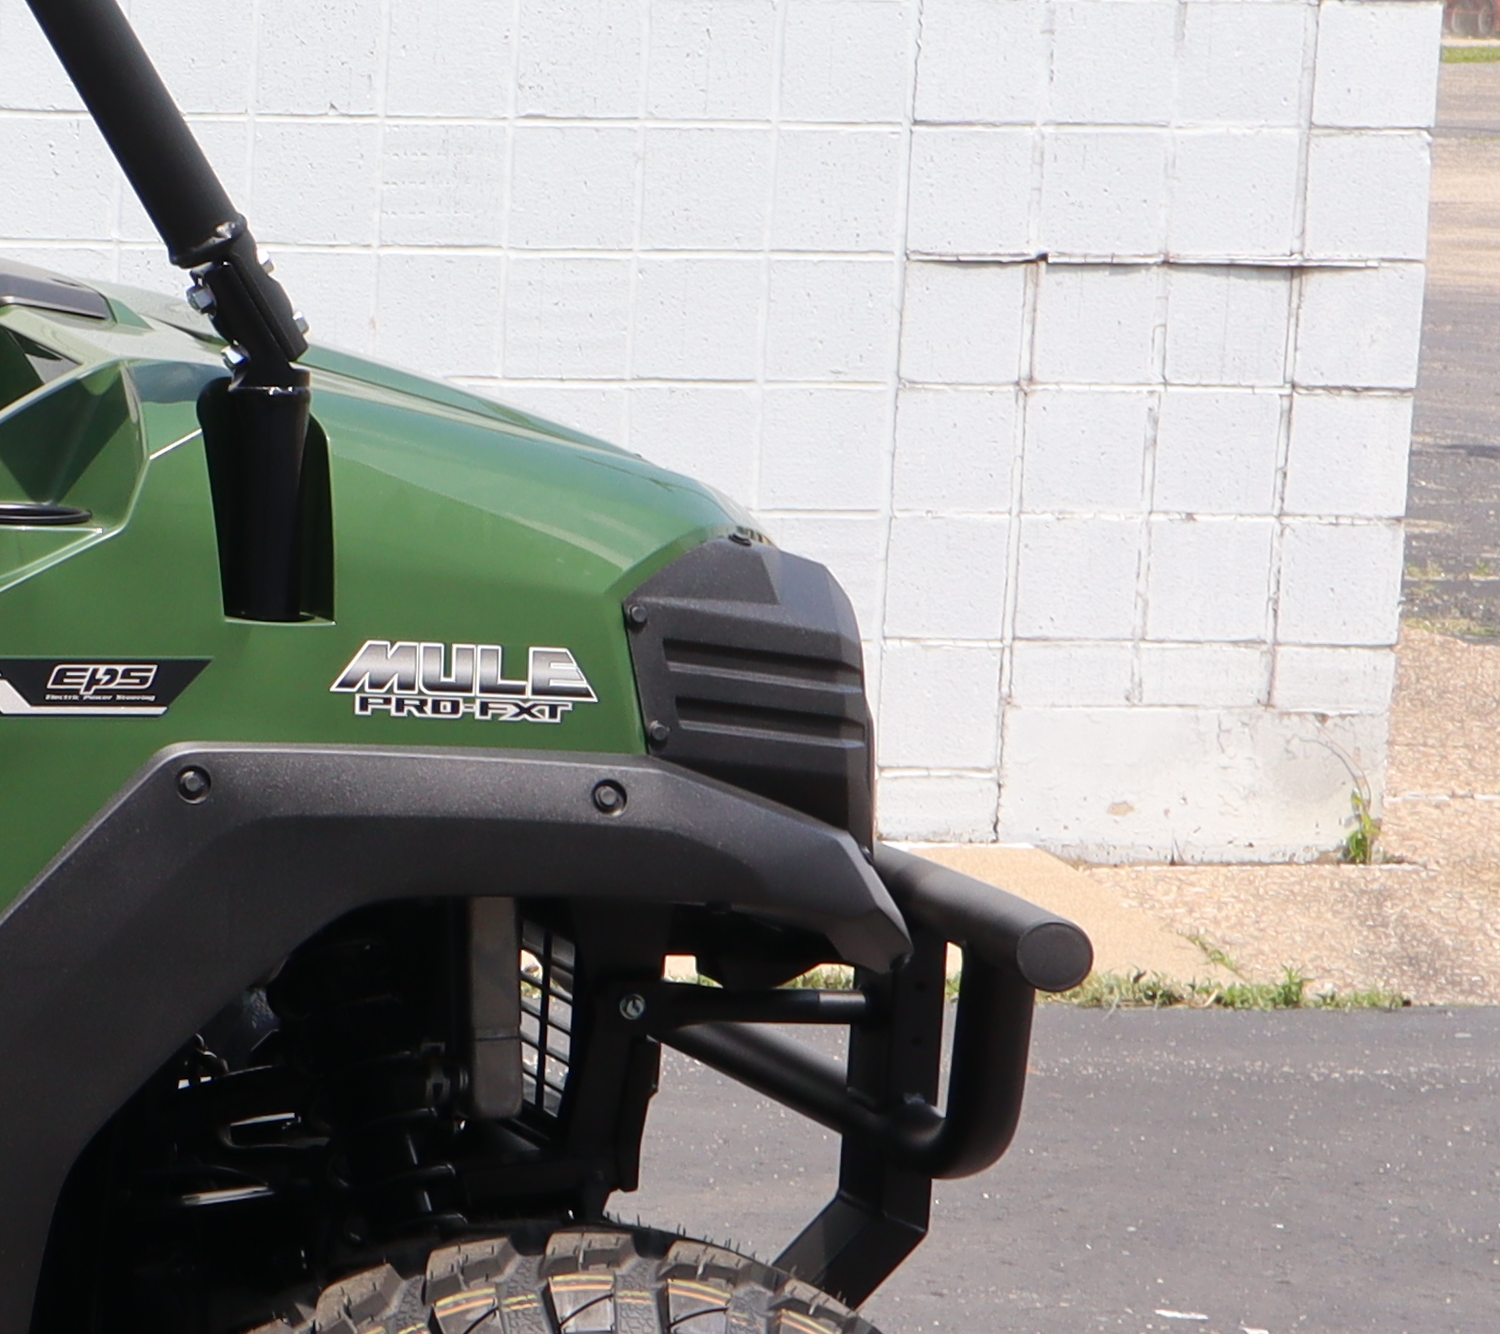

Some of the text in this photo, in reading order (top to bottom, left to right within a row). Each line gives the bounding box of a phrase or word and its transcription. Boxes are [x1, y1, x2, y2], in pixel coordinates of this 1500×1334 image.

[47, 665, 158, 695] EPS
[330, 640, 598, 702] MULE
[355, 694, 573, 723] PRO-FXT
